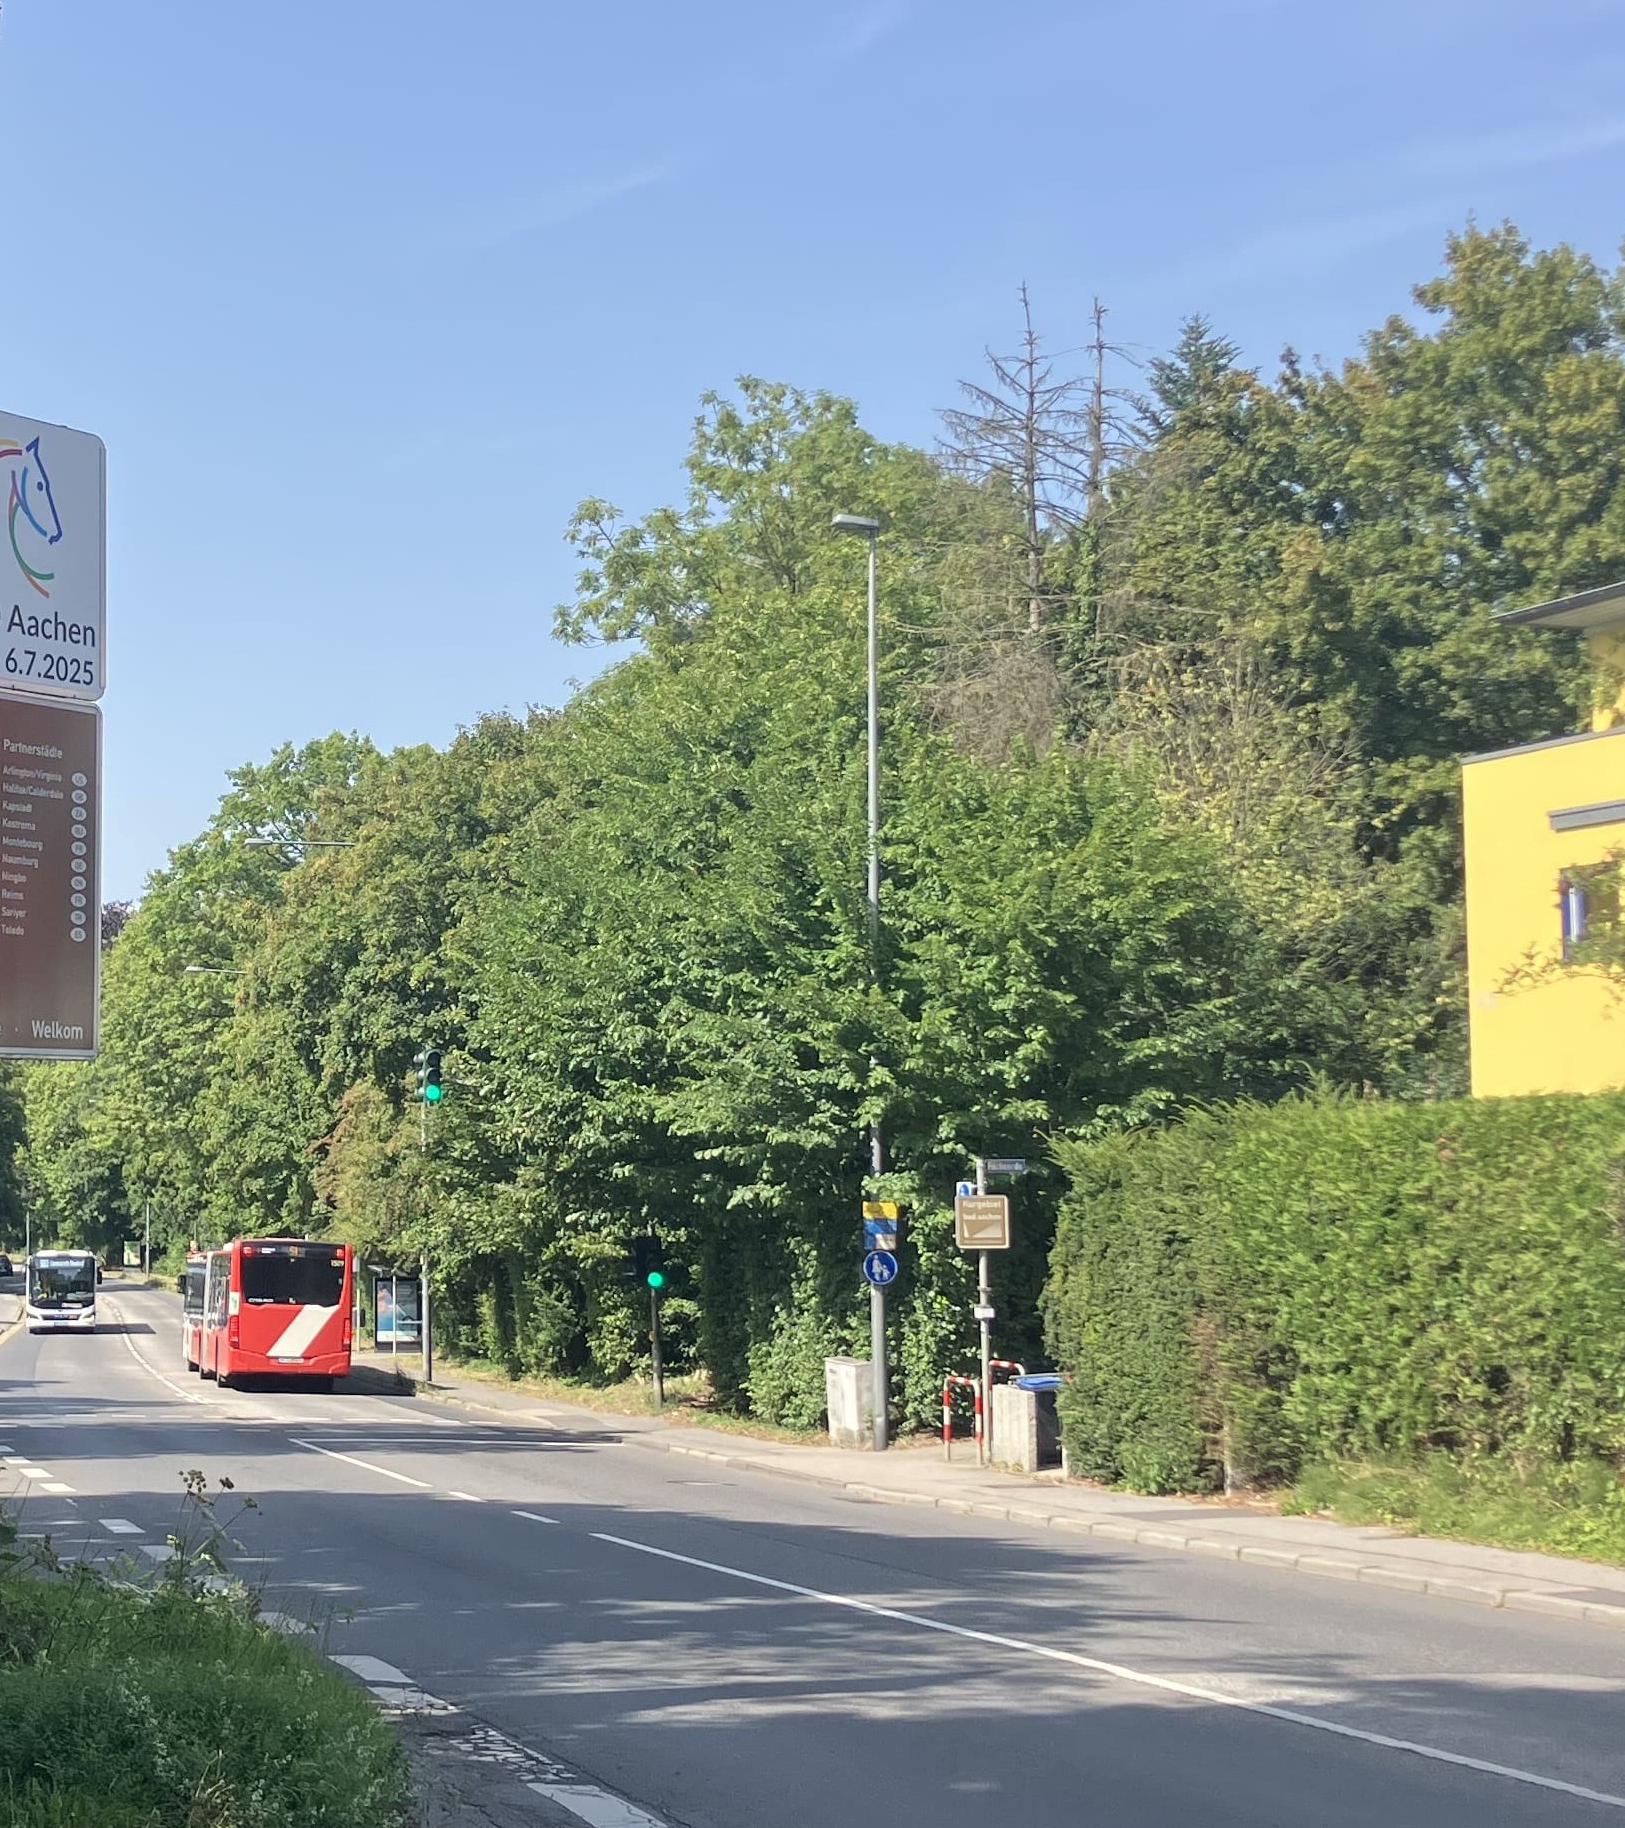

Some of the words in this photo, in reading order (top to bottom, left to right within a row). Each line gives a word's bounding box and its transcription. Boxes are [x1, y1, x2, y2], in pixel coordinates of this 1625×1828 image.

[7, 604, 96, 647] Aachen
[5, 648, 94, 686] 6.7.2025
[3, 738, 63, 758] Partnerstädte
[32, 1020, 83, 1039] Welkom
